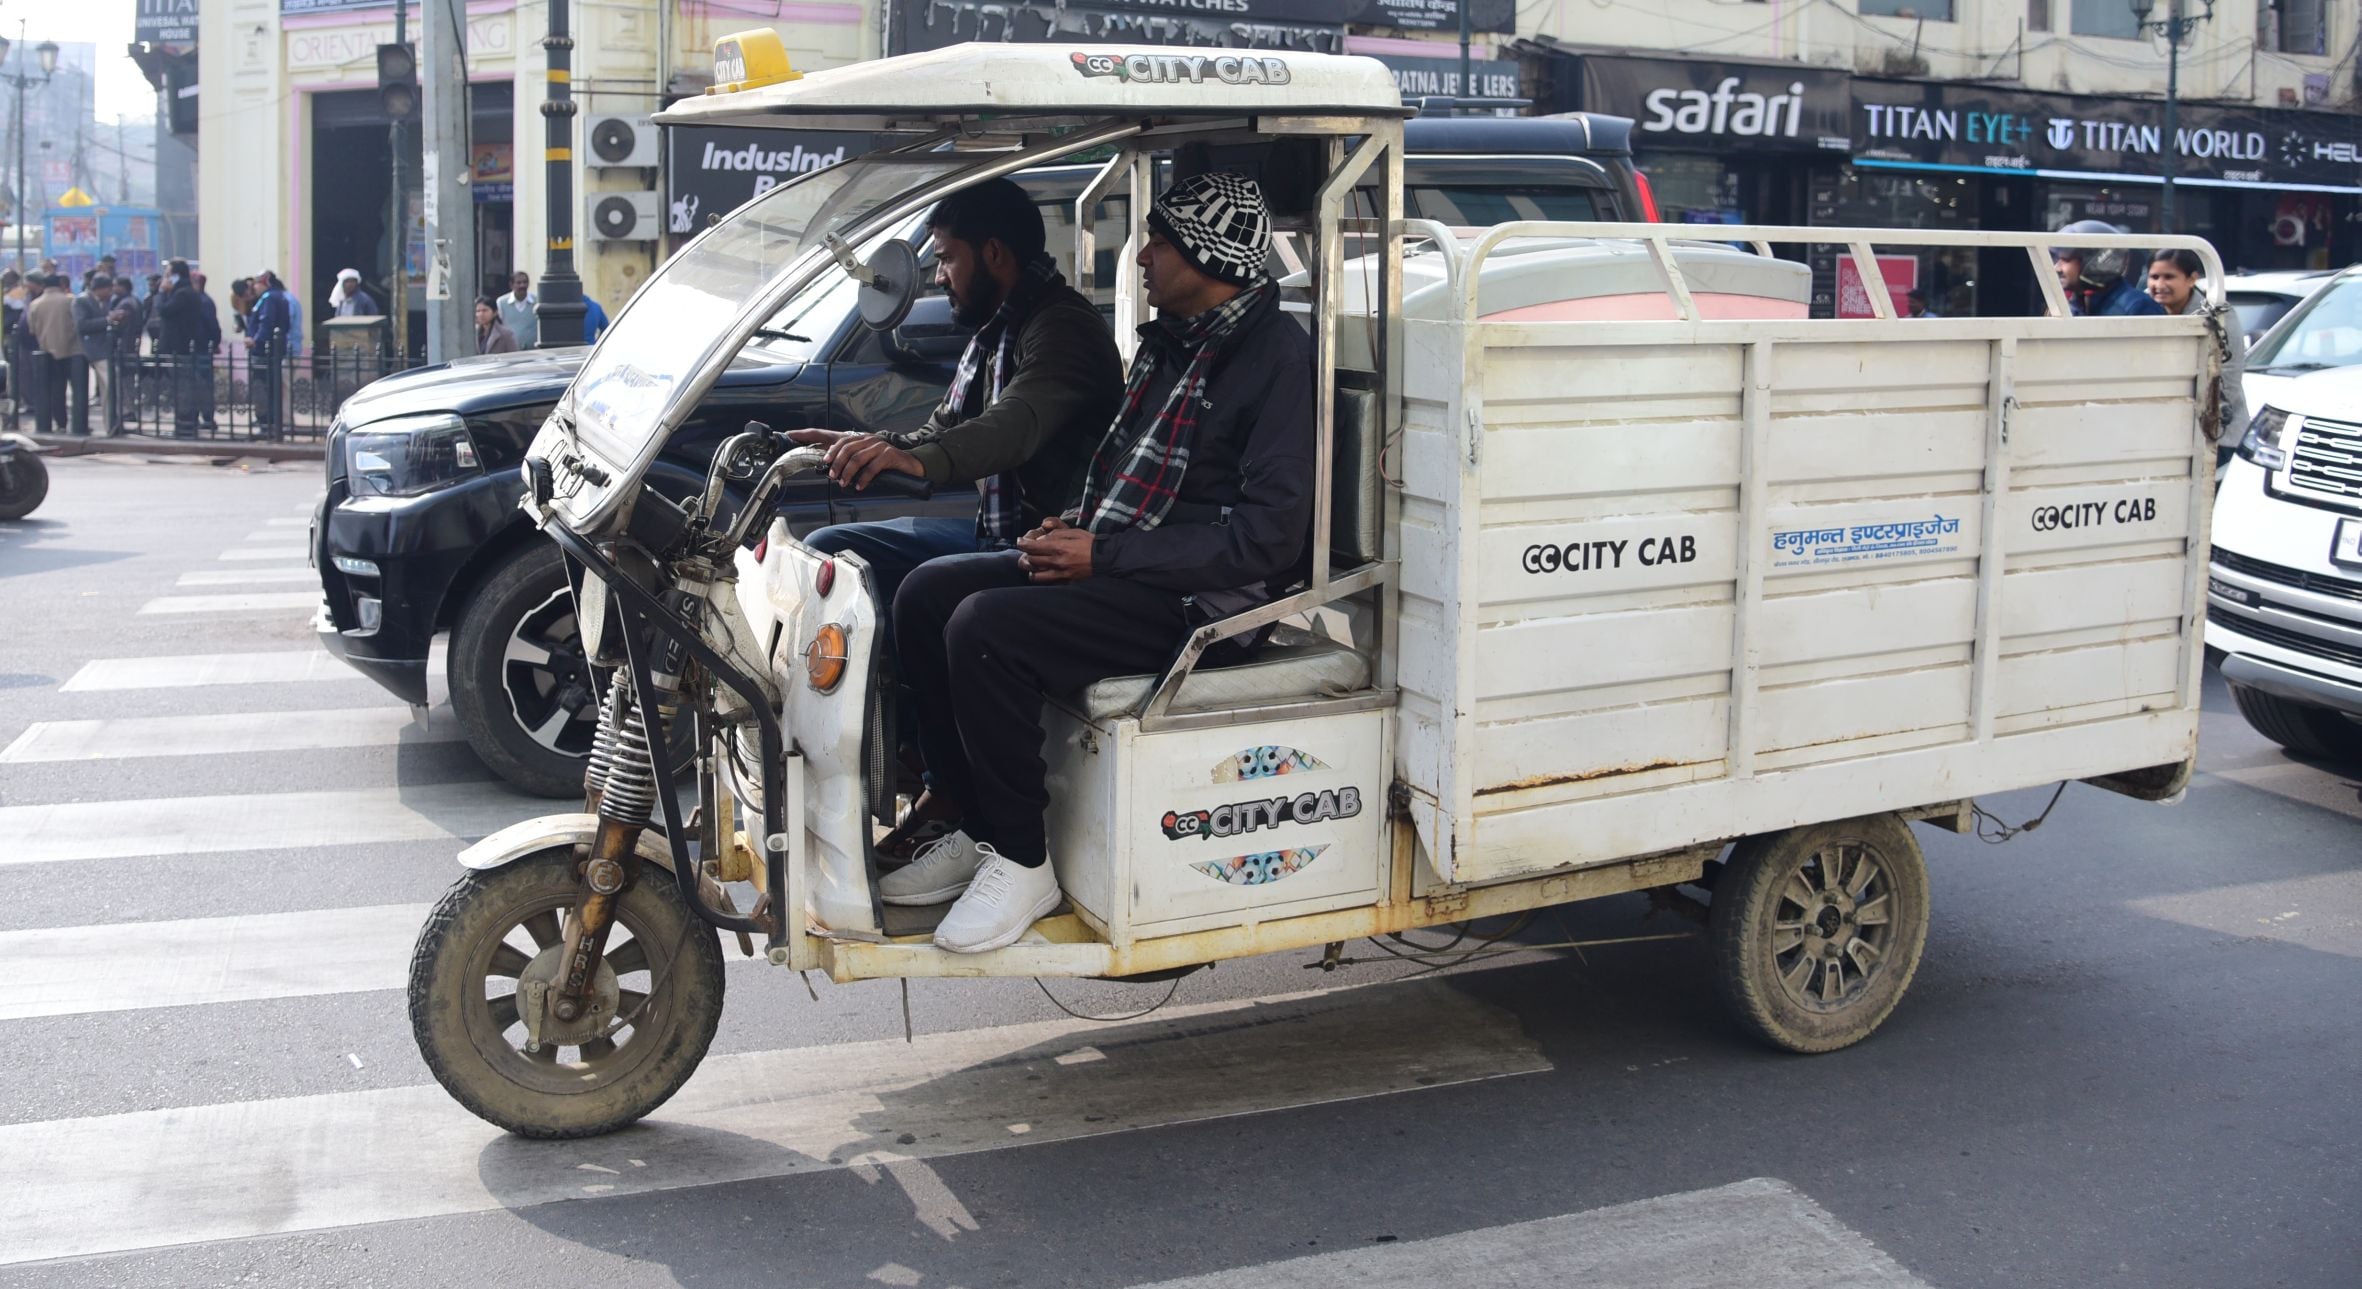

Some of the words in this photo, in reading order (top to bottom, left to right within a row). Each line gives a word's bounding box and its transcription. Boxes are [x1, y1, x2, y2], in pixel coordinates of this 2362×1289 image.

[143, 0, 199, 14] TITA
[159, 28, 190, 39] HOUSE
[293, 30, 387, 62] ORIENTAL
[716, 60, 730, 82] CITY
[731, 57, 745, 81] CAB
[1123, 54, 1204, 83] CITY
[1215, 57, 1291, 85] CAB
[1642, 77, 1804, 137] safari
[1863, 104, 1958, 141] TITAN
[1967, 112, 2032, 144] EYE+
[2081, 120, 2161, 153] TITAN
[2173, 128, 2265, 160] WORLD
[702, 142, 845, 172] IndusInd
[2060, 501, 2108, 529] CITY
[2114, 498, 2156, 523] CAB
[1562, 540, 1629, 572] CITY
[1638, 535, 1697, 566] CAB
[1773, 528, 1845, 555] हनुमन्त
[1210, 796, 1288, 837] CITY
[1292, 786, 1361, 824] CAB
